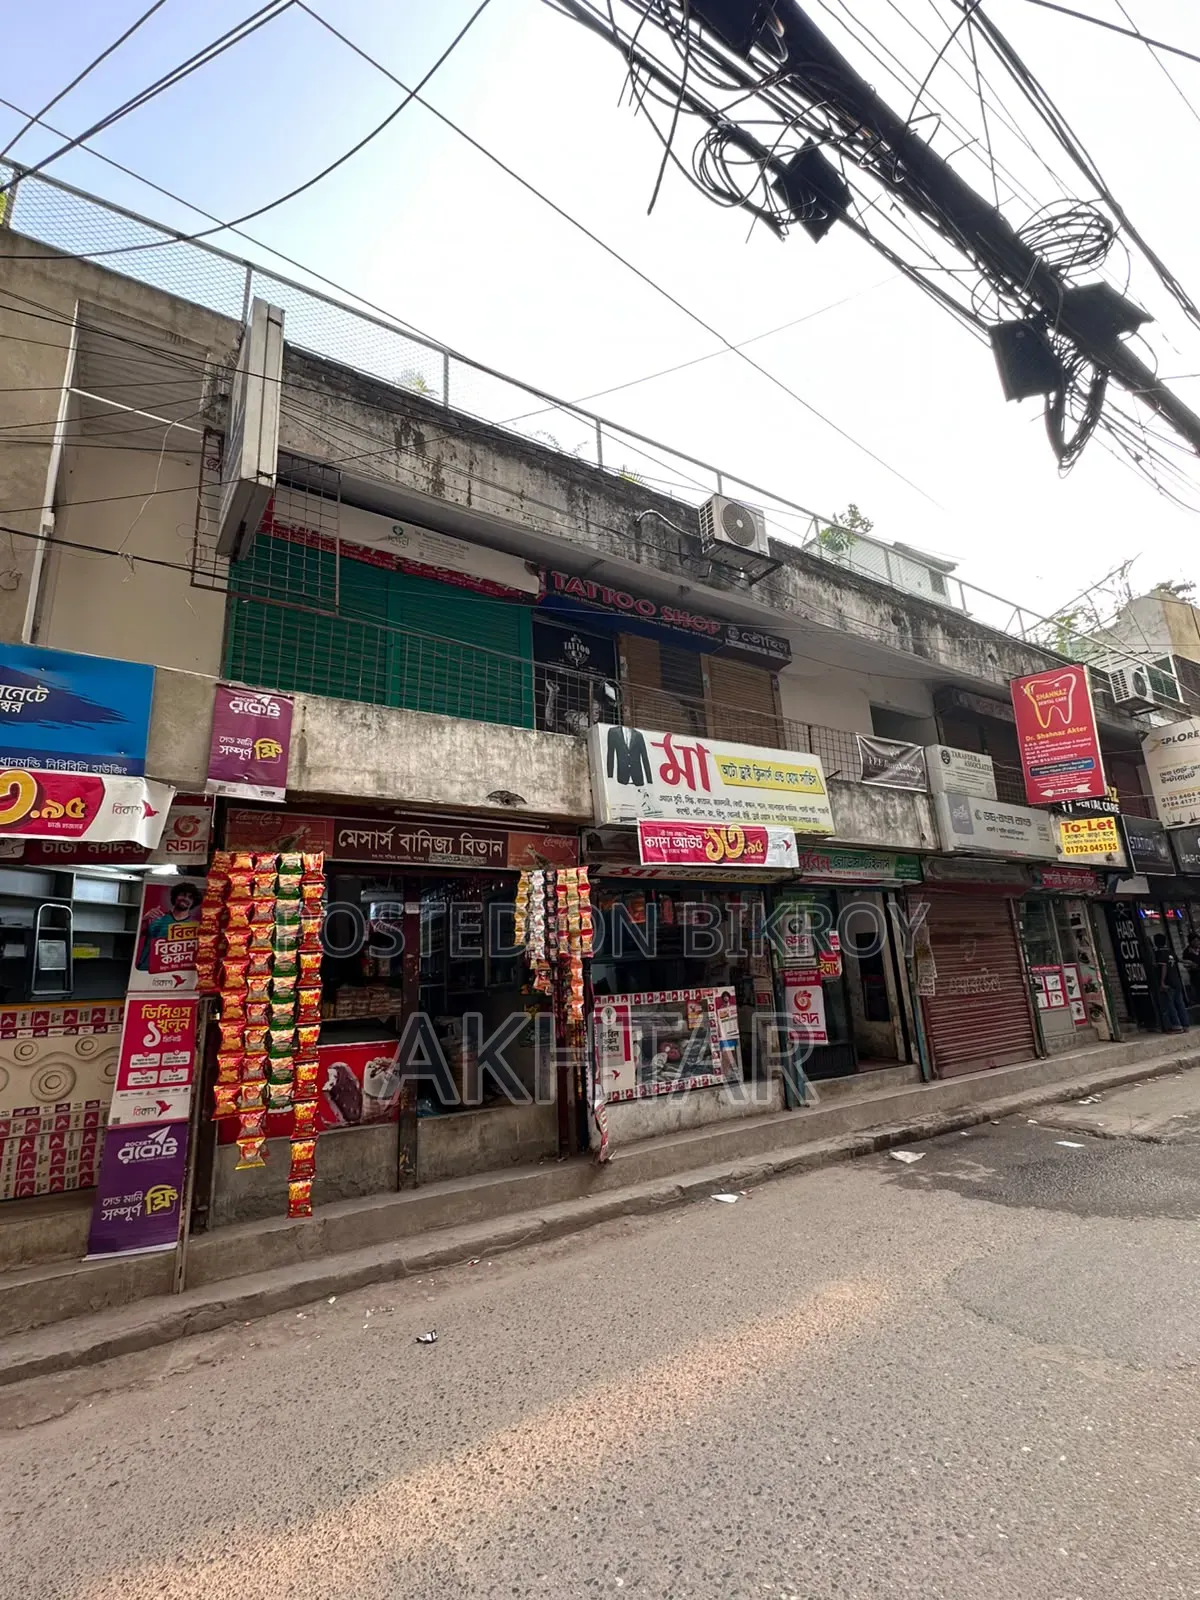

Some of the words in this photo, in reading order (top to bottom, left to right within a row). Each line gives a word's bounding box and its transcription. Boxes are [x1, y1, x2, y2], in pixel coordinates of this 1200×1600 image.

[552, 571, 656, 616] TATTOO
[660, 606, 721, 634] SHOP
[564, 641, 590, 655] TATTOO
[229, 700, 281, 717] রকেট
[1025, 734, 1035, 742] Dr.
[1036, 730, 1065, 740] Shahnaz
[1067, 726, 1087, 735] Akter
[219, 745, 253, 760] সম্পূর্ণ
[254, 738, 283, 759] ফ্রি
[46, 758, 89, 774] নিরিবিলি
[91, 763, 128, 775] হাউজিং
[651, 733, 711, 792] মা
[112, 803, 142, 815] বিকাশ
[1102, 801, 1119, 813] CARE
[1061, 819, 1115, 833] To-Let
[166, 840, 207, 852] নগদ
[338, 826, 396, 851] মেসার্স
[399, 830, 454, 854] বানিজ্য
[459, 834, 504, 856] বিতান
[644, 836, 671, 849] ক্যাশ
[672, 834, 703, 849] আউট
[1065, 845, 1089, 854] 01792
[1089, 842, 1118, 852] 045155
[170, 925, 198, 940] বিল
[1116, 920, 1137, 939] HAIR
[155, 939, 198, 955] বিকাশ
[1121, 941, 1139, 959] CUT
[160, 952, 194, 964] করুন
[141, 1004, 192, 1019] ডিপিএস
[792, 1013, 820, 1025] নগদ
[157, 1018, 190, 1033] খুলুন
[133, 1106, 157, 1116] বিকাশ
[117, 1137, 179, 1164] রকেট
[101, 1202, 143, 1222] সম্পূর্ণ
[144, 1184, 179, 1215] ফ্রি
